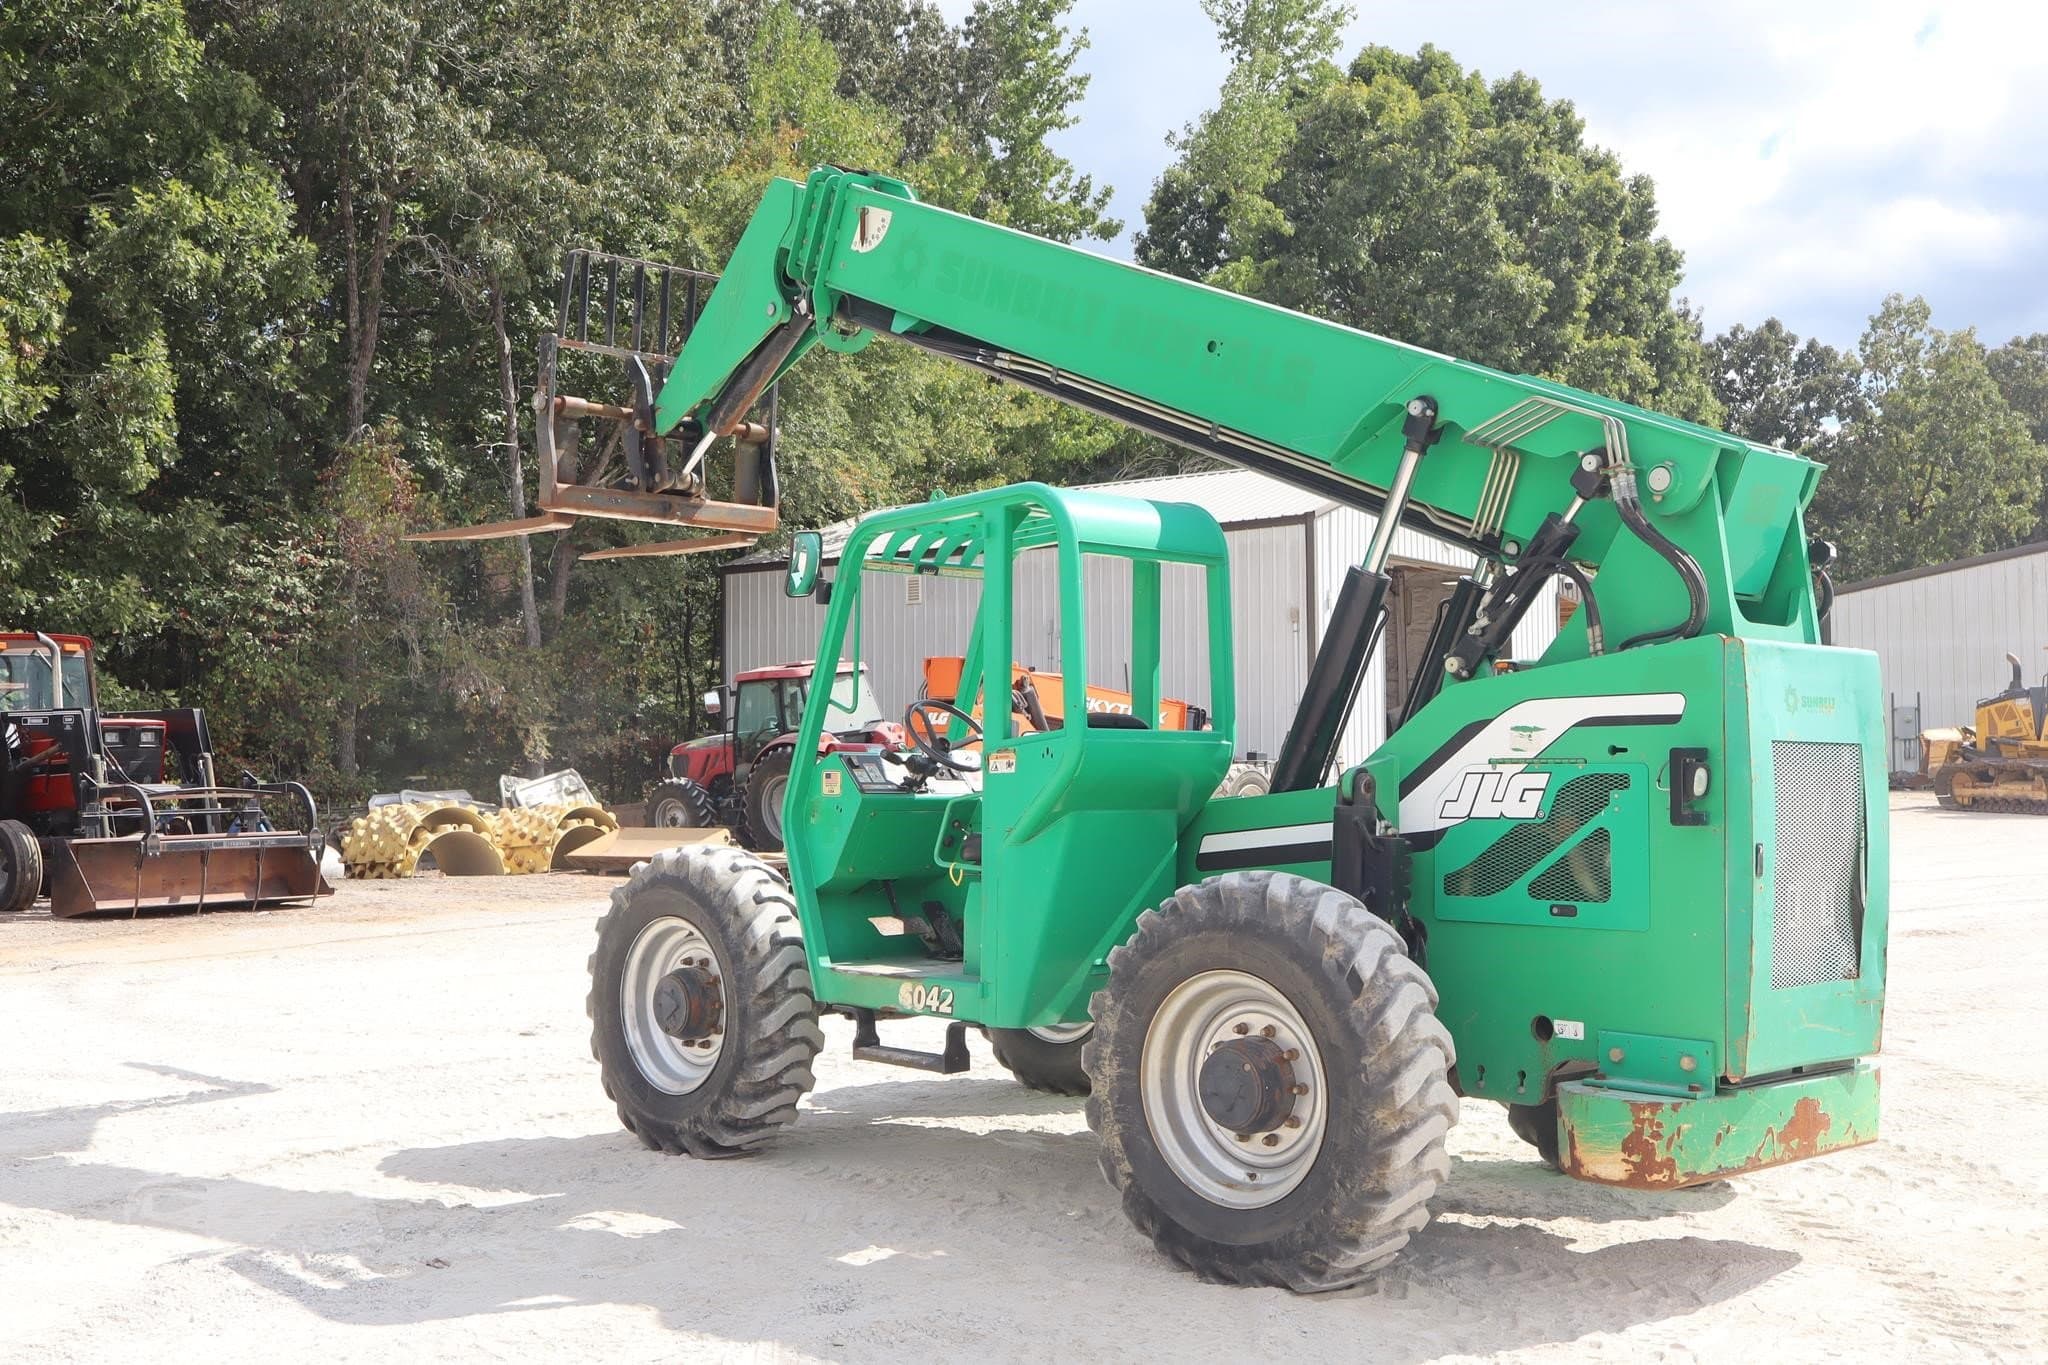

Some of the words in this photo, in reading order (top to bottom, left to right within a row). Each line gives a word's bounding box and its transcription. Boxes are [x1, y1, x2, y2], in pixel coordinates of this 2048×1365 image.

[936, 249, 1108, 336] SUNBELT
[1439, 772, 1552, 820] JLG
[898, 981, 955, 1014] 6042
